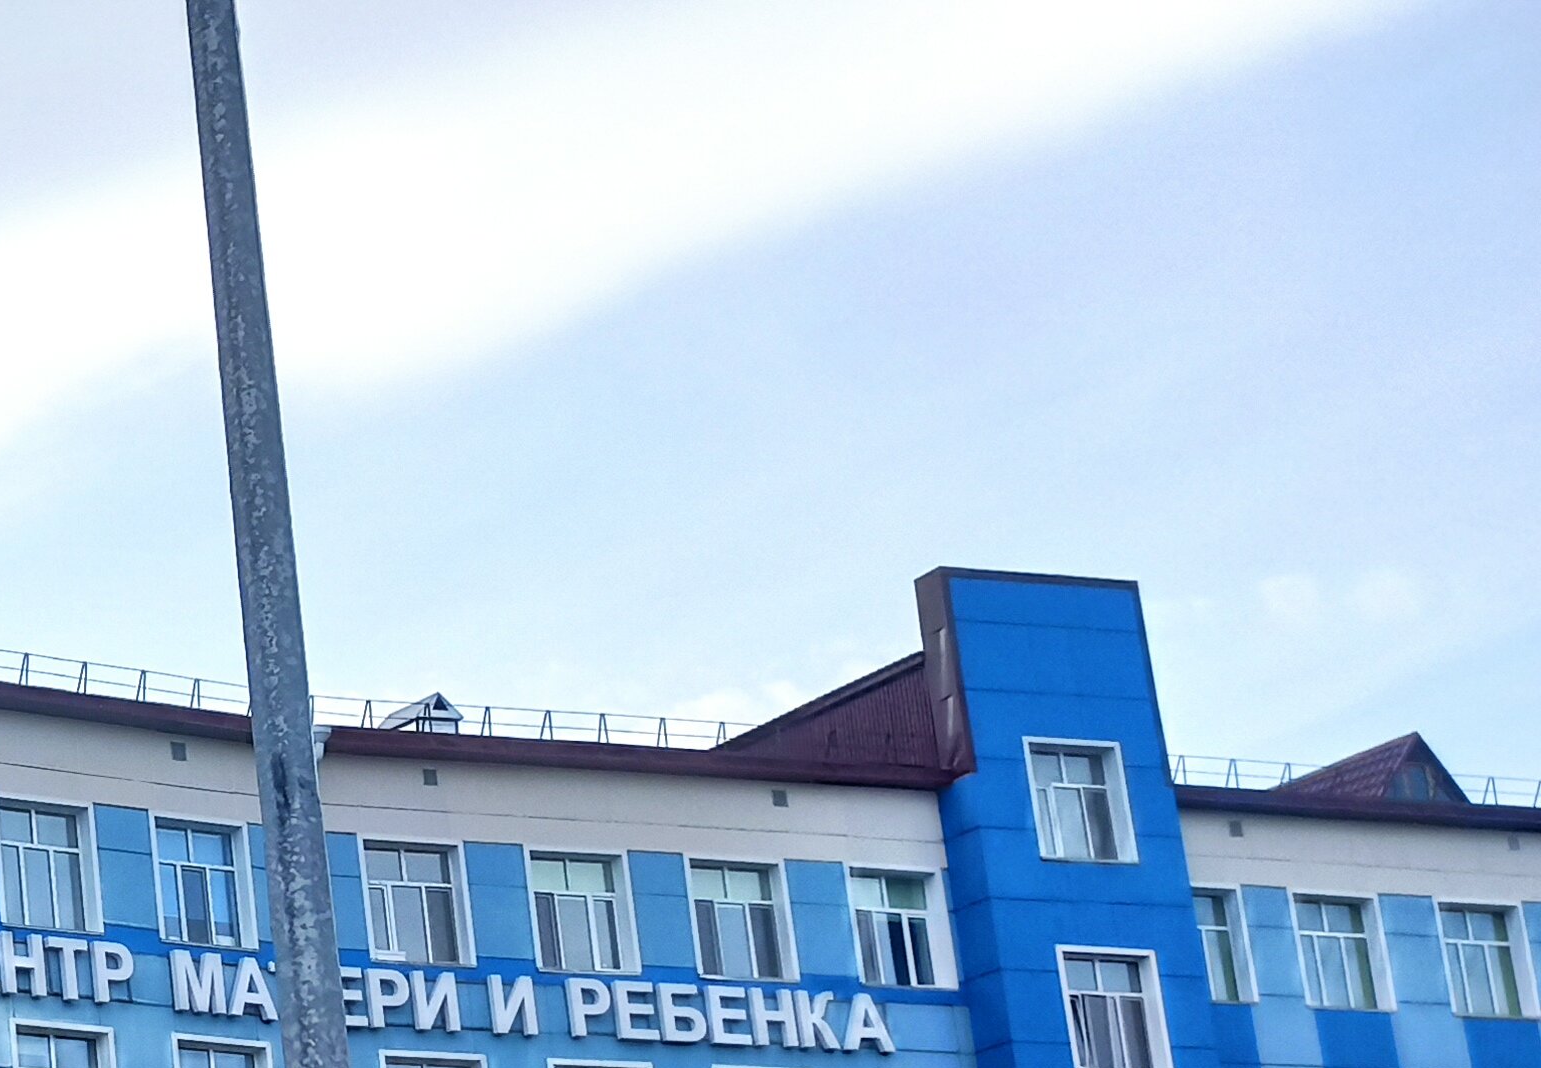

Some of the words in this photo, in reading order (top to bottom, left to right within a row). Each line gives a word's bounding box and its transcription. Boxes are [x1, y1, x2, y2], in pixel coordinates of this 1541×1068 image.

[169, 948, 462, 1033] МАЕРИ
[487, 974, 539, 1036] И
[564, 977, 896, 1053] РЕБЕНКА
